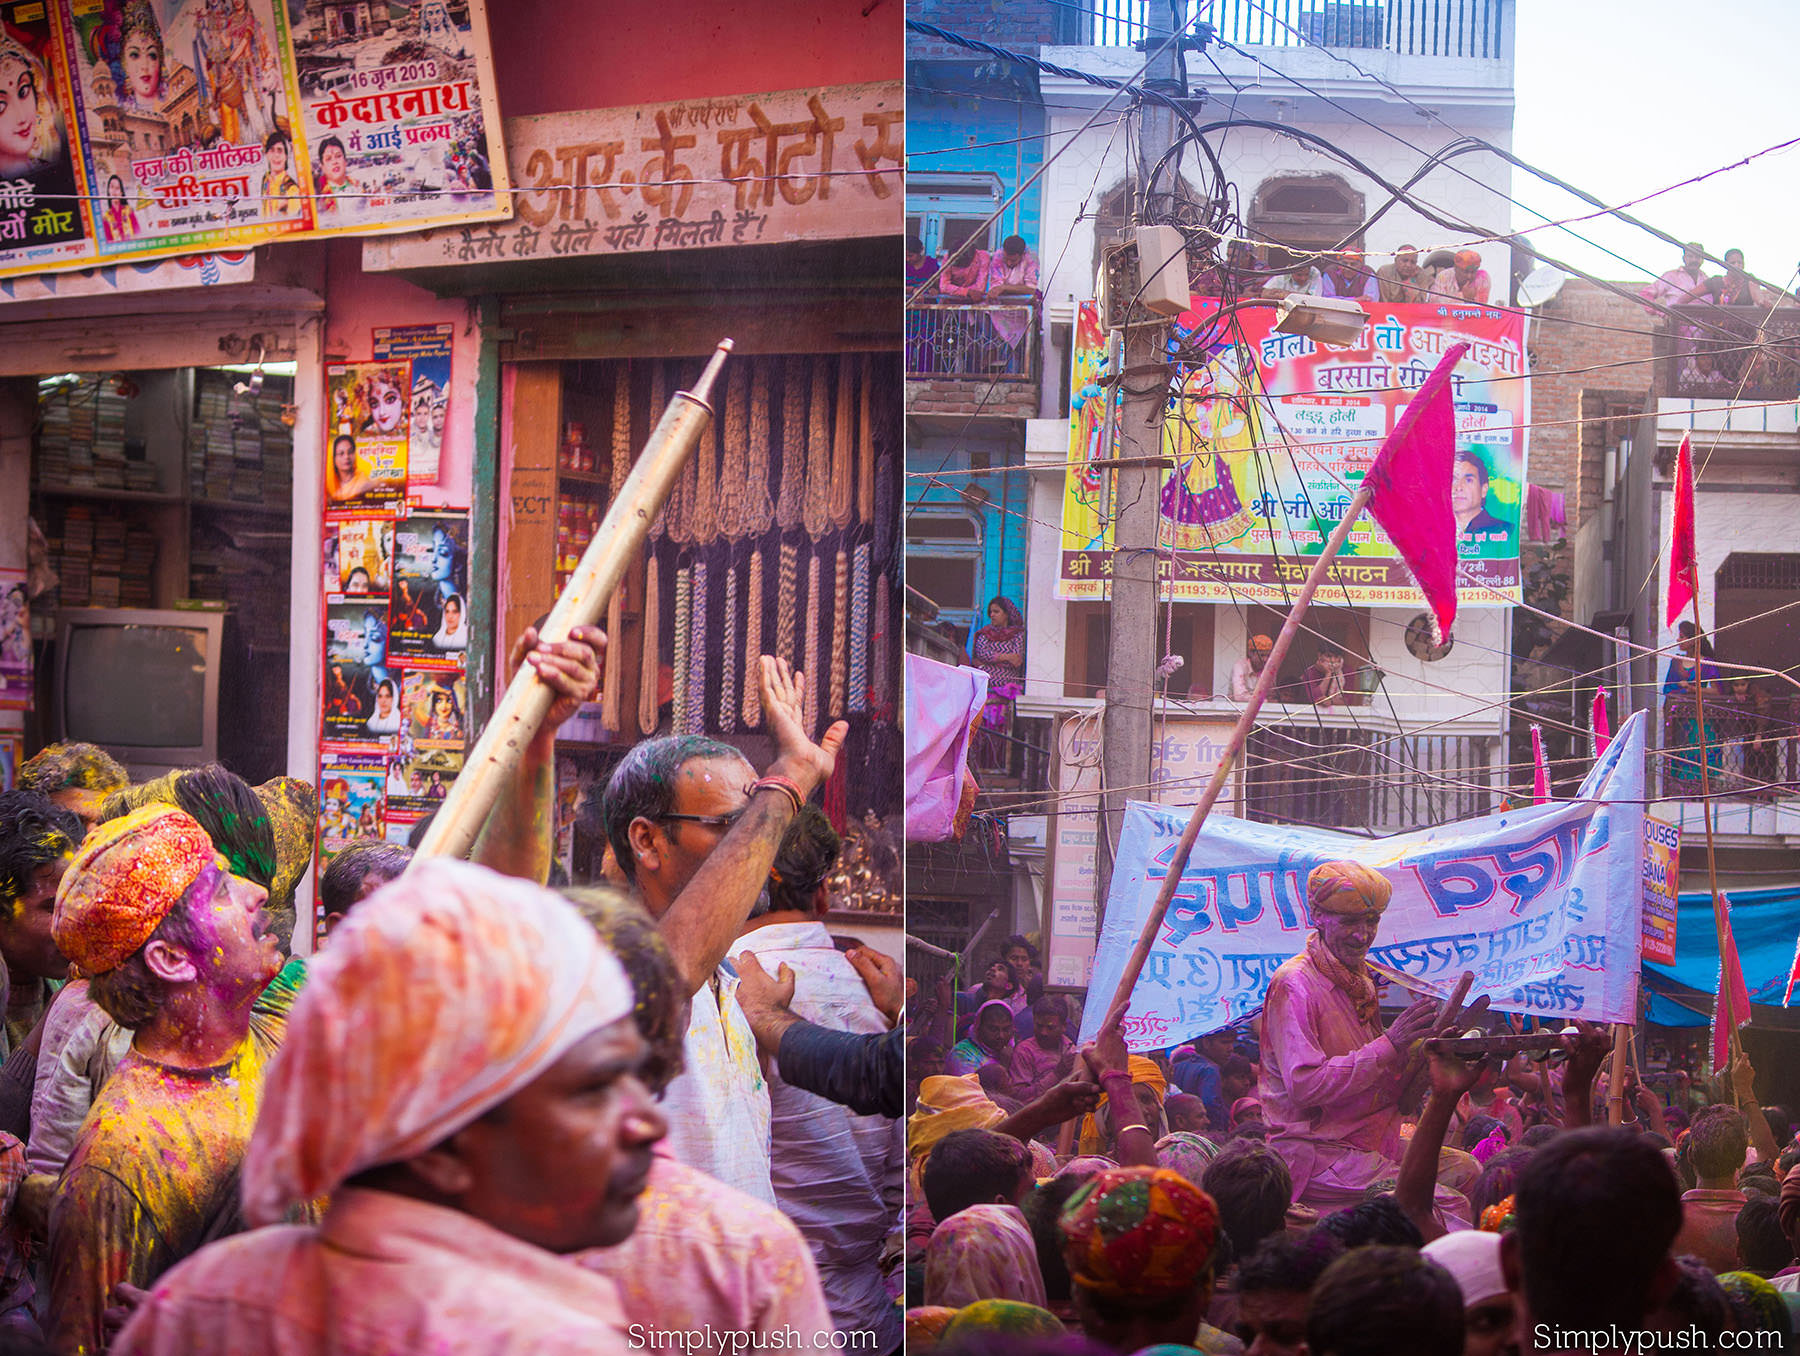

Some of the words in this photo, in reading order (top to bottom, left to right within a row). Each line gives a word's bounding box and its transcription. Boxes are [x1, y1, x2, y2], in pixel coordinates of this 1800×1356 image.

[350, 73, 368, 89] 16
[370, 66, 397, 91] जून
[400, 62, 437, 82] 2013
[310, 82, 473, 129] केदारनाथ
[348, 129, 363, 152] में
[366, 124, 402, 151] आई
[404, 123, 451, 146] प्रलय
[167, 148, 194, 175] की
[197, 143, 263, 170] मालिक
[717, 96, 846, 212] फोटो
[153, 174, 250, 210] राधिका
[31, 207, 74, 236] मोर
[513, 225, 541, 257] की
[1376, 315, 1404, 349] तो
[1318, 356, 1393, 389] बरसाने
[1329, 407, 1357, 425] होली
[1461, 413, 1488, 429] होली
[1284, 493, 1310, 519] जी
[1068, 552, 1092, 576] श्री
